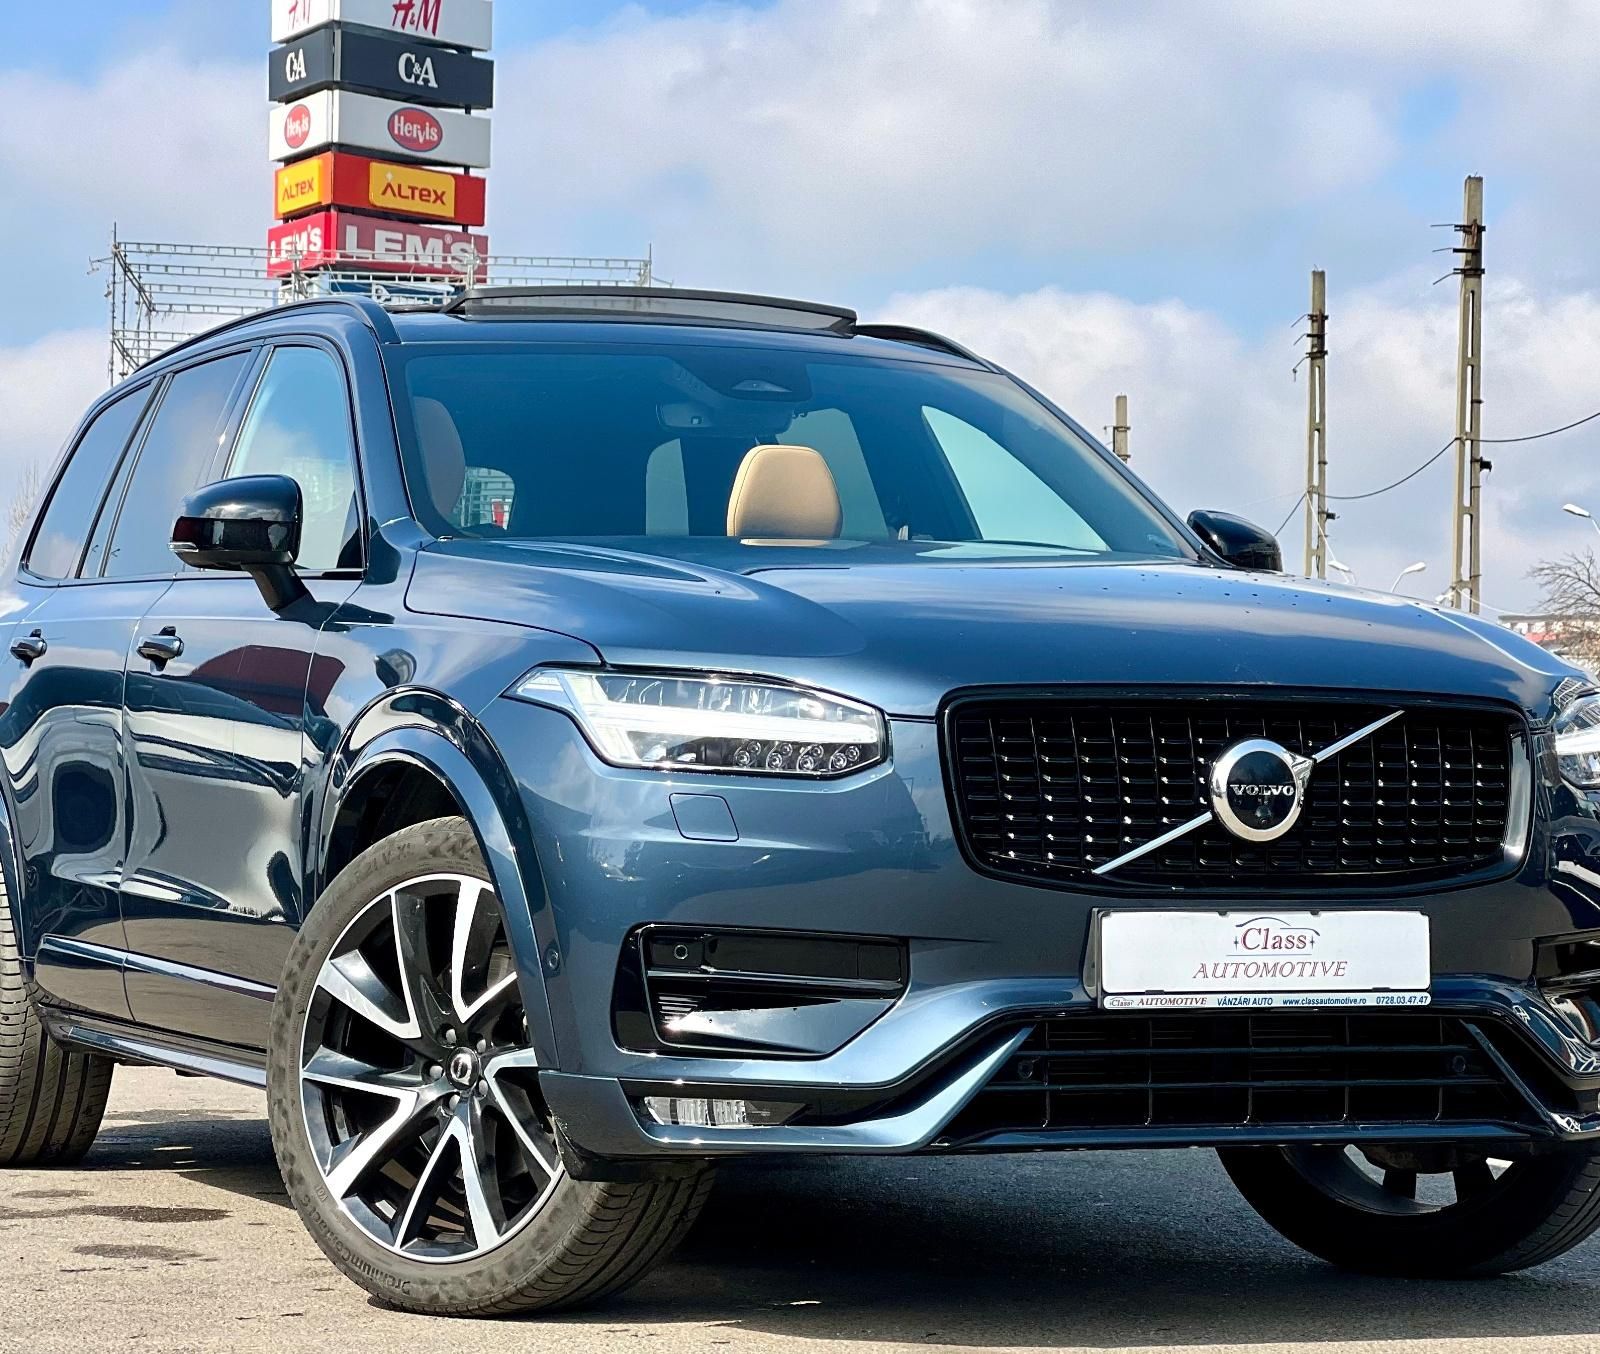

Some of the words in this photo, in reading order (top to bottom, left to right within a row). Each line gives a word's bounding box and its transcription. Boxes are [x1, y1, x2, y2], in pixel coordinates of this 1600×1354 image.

[392, 0, 441, 37] H&M
[285, 48, 306, 83] C&A
[398, 52, 438, 88] C&A
[286, 110, 309, 139] Hervis
[394, 114, 438, 144] Hervis
[1229, 784, 1295, 796] VOLVO
[1240, 927, 1309, 950] Class
[1192, 960, 1348, 980] AUTOMOTIVE
[1137, 997, 1208, 1006] AUTOMOTIVE
[1252, 997, 1273, 1006] AUTO
[1282, 996, 1367, 1006] www.classautomotive.ro
[1376, 995, 1428, 1005] 0728.03.47.47
